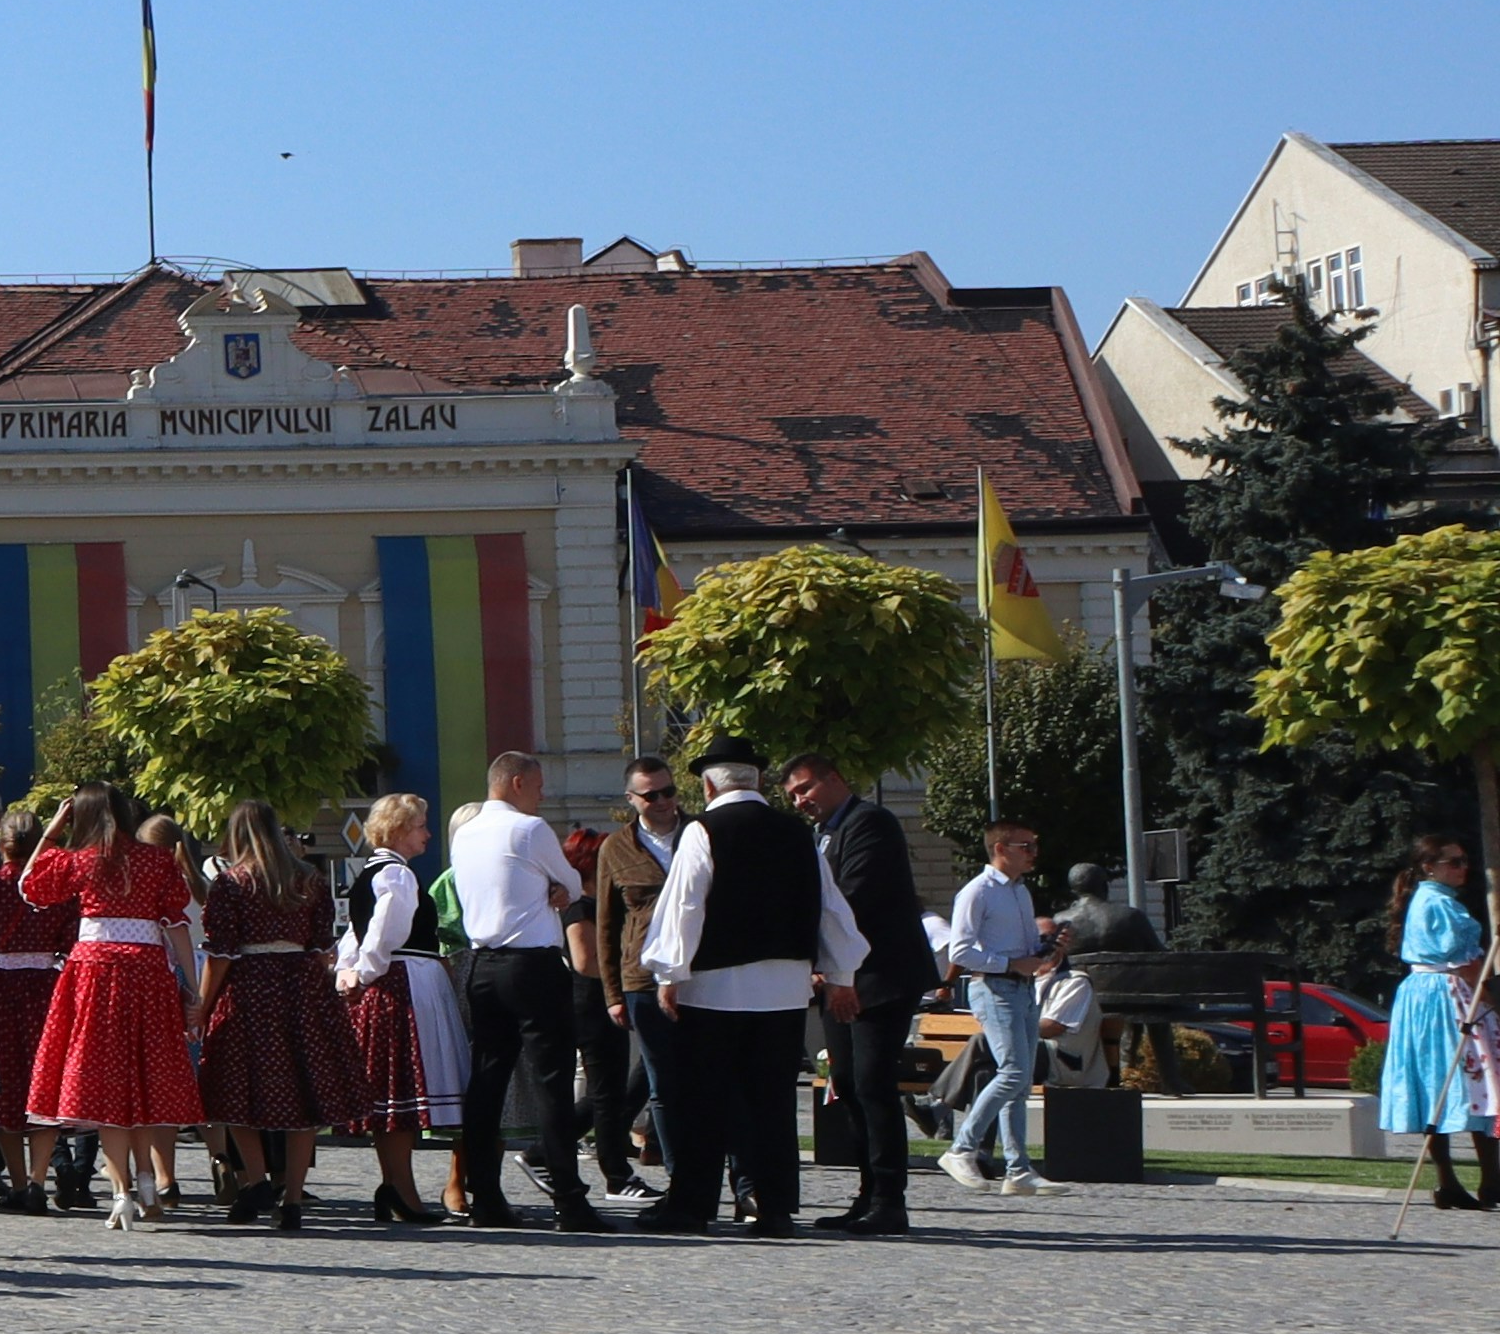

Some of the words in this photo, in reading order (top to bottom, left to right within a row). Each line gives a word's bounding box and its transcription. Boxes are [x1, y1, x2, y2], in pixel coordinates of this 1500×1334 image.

[0, 410, 128, 439] PRIMARIA
[159, 407, 332, 436] MUNICIPIULUI
[366, 404, 457, 433] ZALAU
